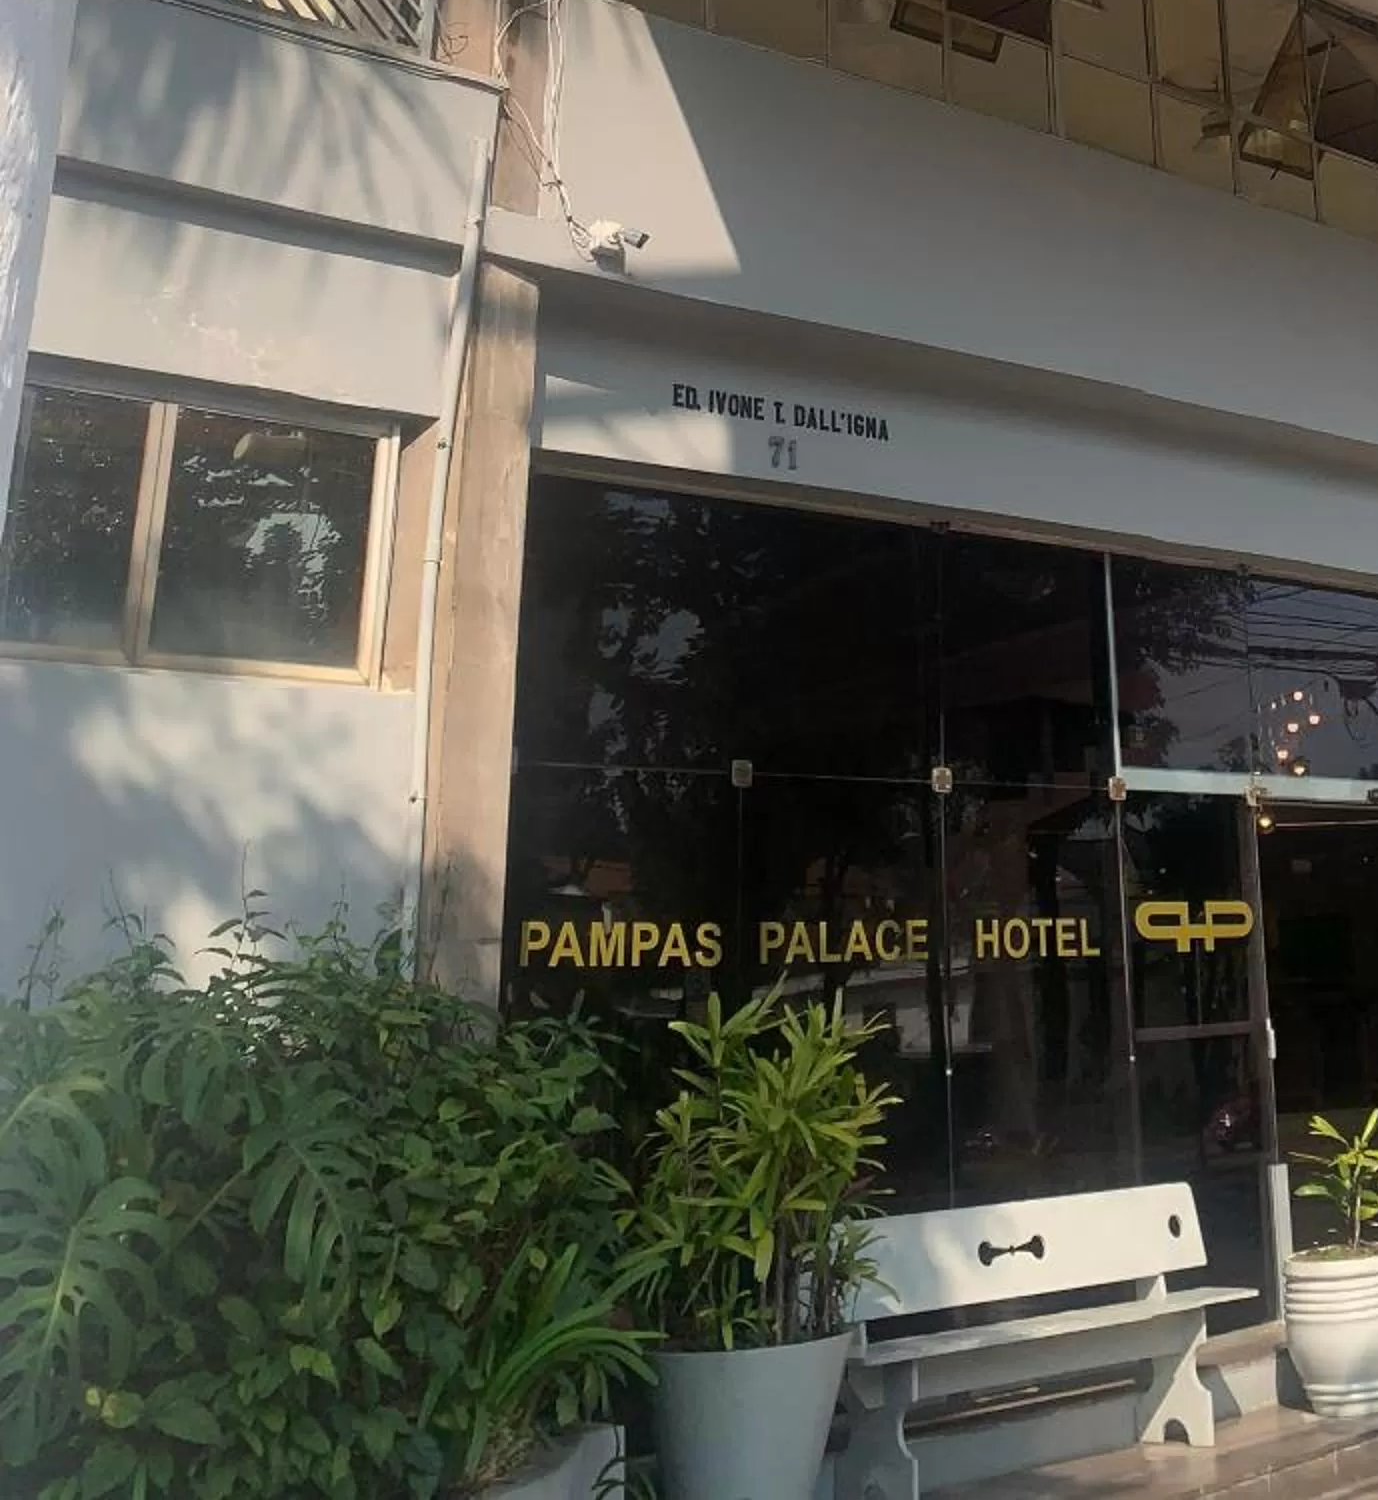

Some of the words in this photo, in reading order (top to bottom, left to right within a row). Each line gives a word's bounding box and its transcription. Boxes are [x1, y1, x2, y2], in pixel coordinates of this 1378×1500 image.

[672, 383, 701, 411] ED.
[708, 389, 765, 421] IVONE
[793, 403, 889, 442] DALL'IGNA
[767, 435, 799, 471] 71
[519, 919, 722, 967] PAMPAS
[757, 918, 930, 965] PALACE
[974, 916, 1101, 960] HOTEL
